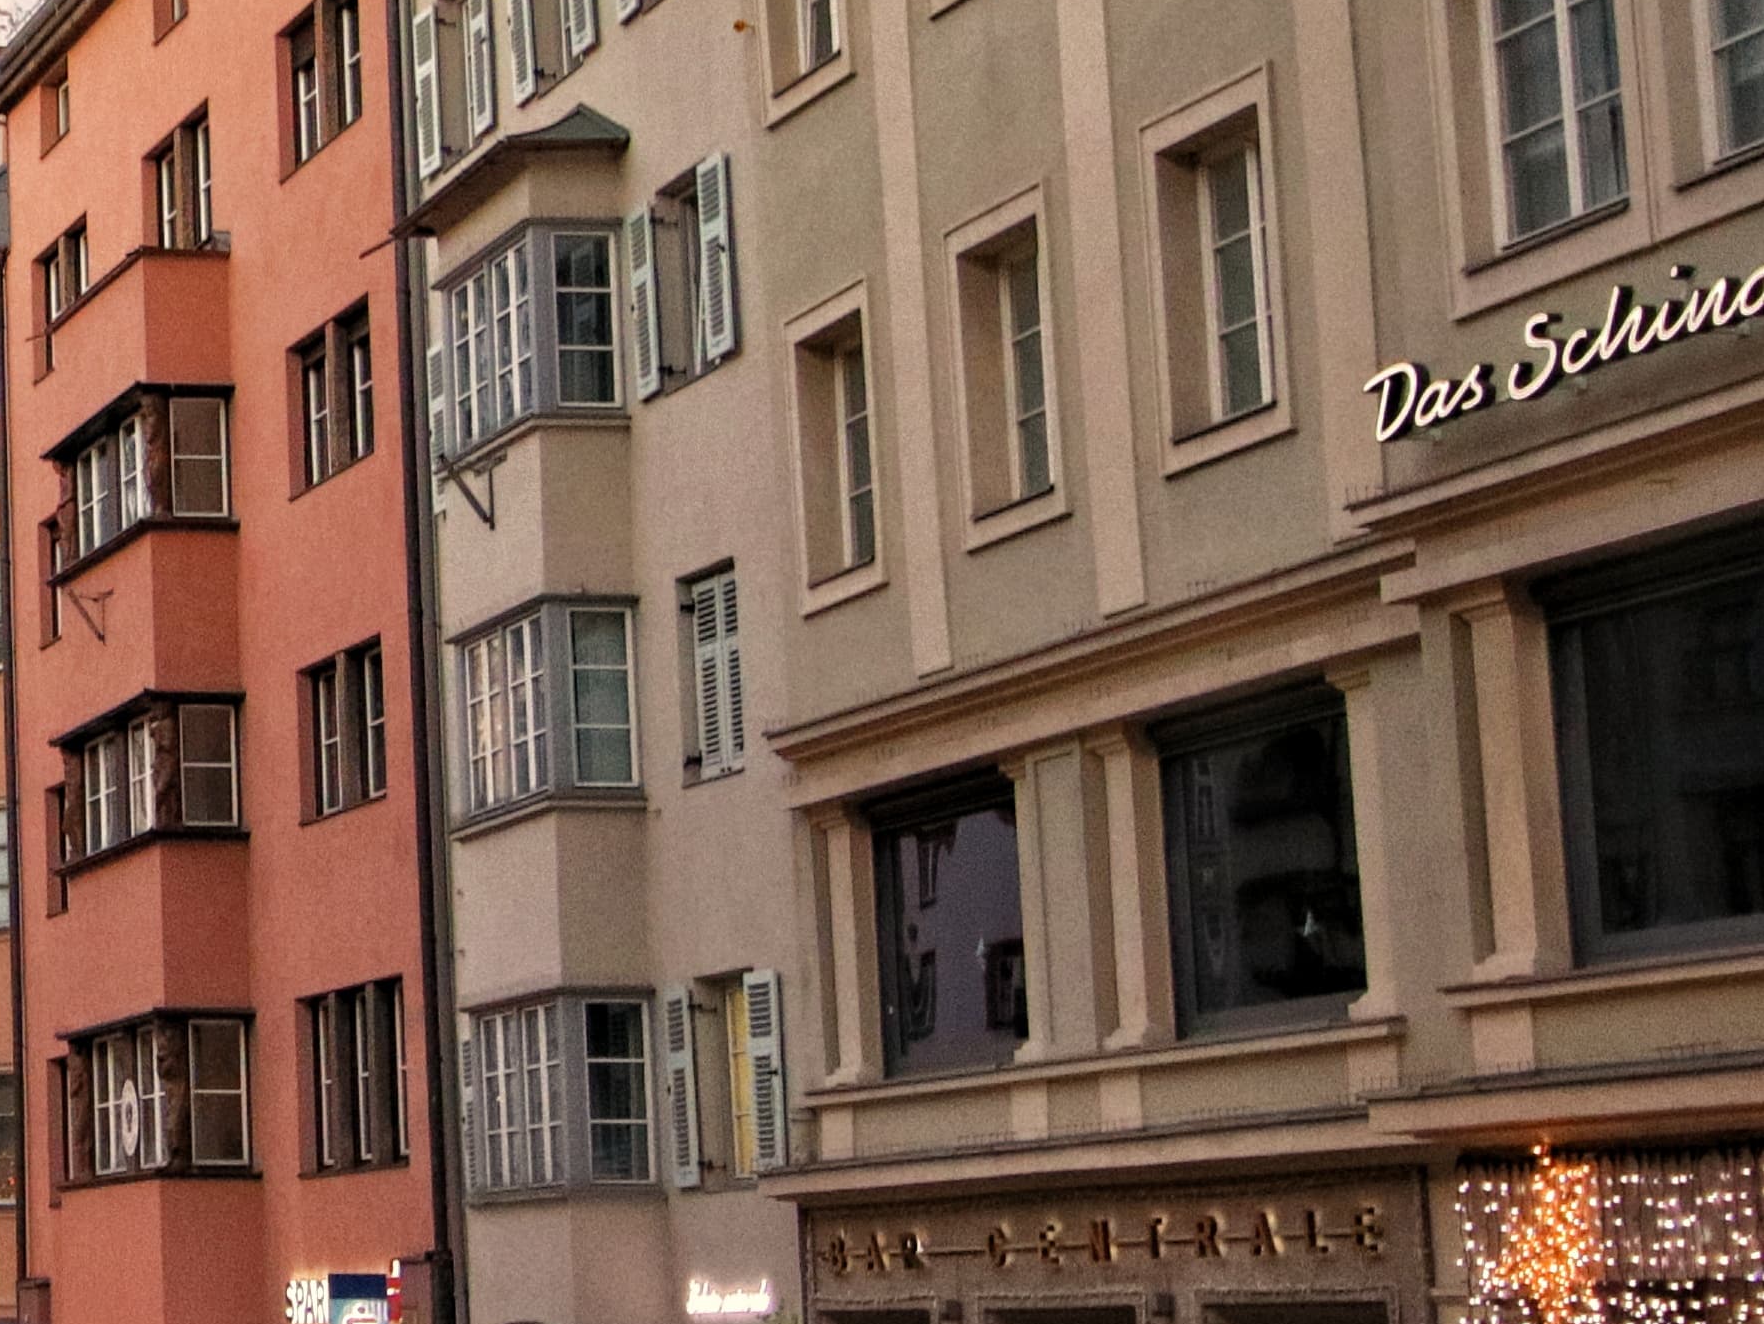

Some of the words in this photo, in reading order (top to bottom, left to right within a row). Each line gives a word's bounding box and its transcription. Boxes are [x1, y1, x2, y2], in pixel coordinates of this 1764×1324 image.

[1363, 362, 1486, 443] Das
[826, 1227, 926, 1274] BAR
[985, 1207, 1383, 1267] CENTRALE
[285, 1279, 330, 1324] SPAR
